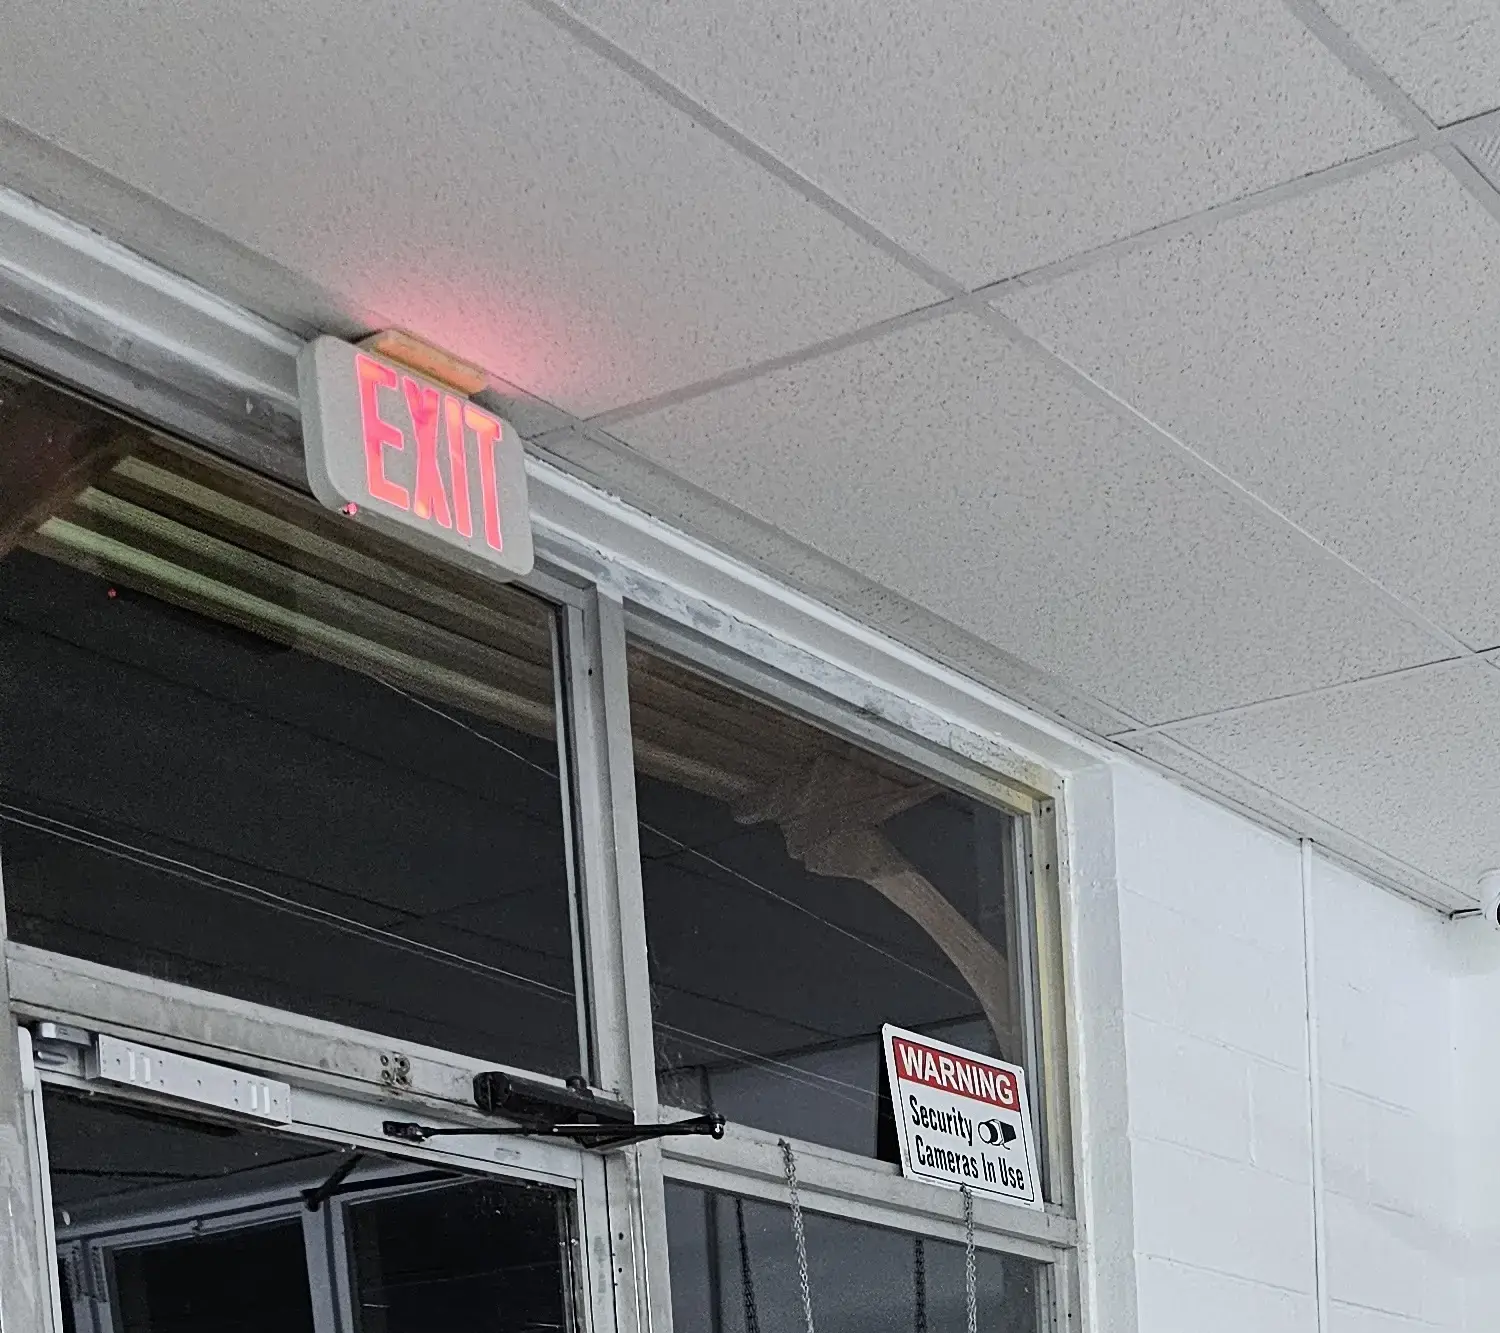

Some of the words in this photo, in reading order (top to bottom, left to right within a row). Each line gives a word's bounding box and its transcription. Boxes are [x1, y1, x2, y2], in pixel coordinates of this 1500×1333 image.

[355, 353, 503, 552] EXIT
[898, 1043, 1014, 1105] WARNING
[909, 1094, 973, 1146] Security
[915, 1134, 979, 1179] Cameras
[981, 1153, 997, 1184] In
[998, 1157, 1025, 1191] Use
